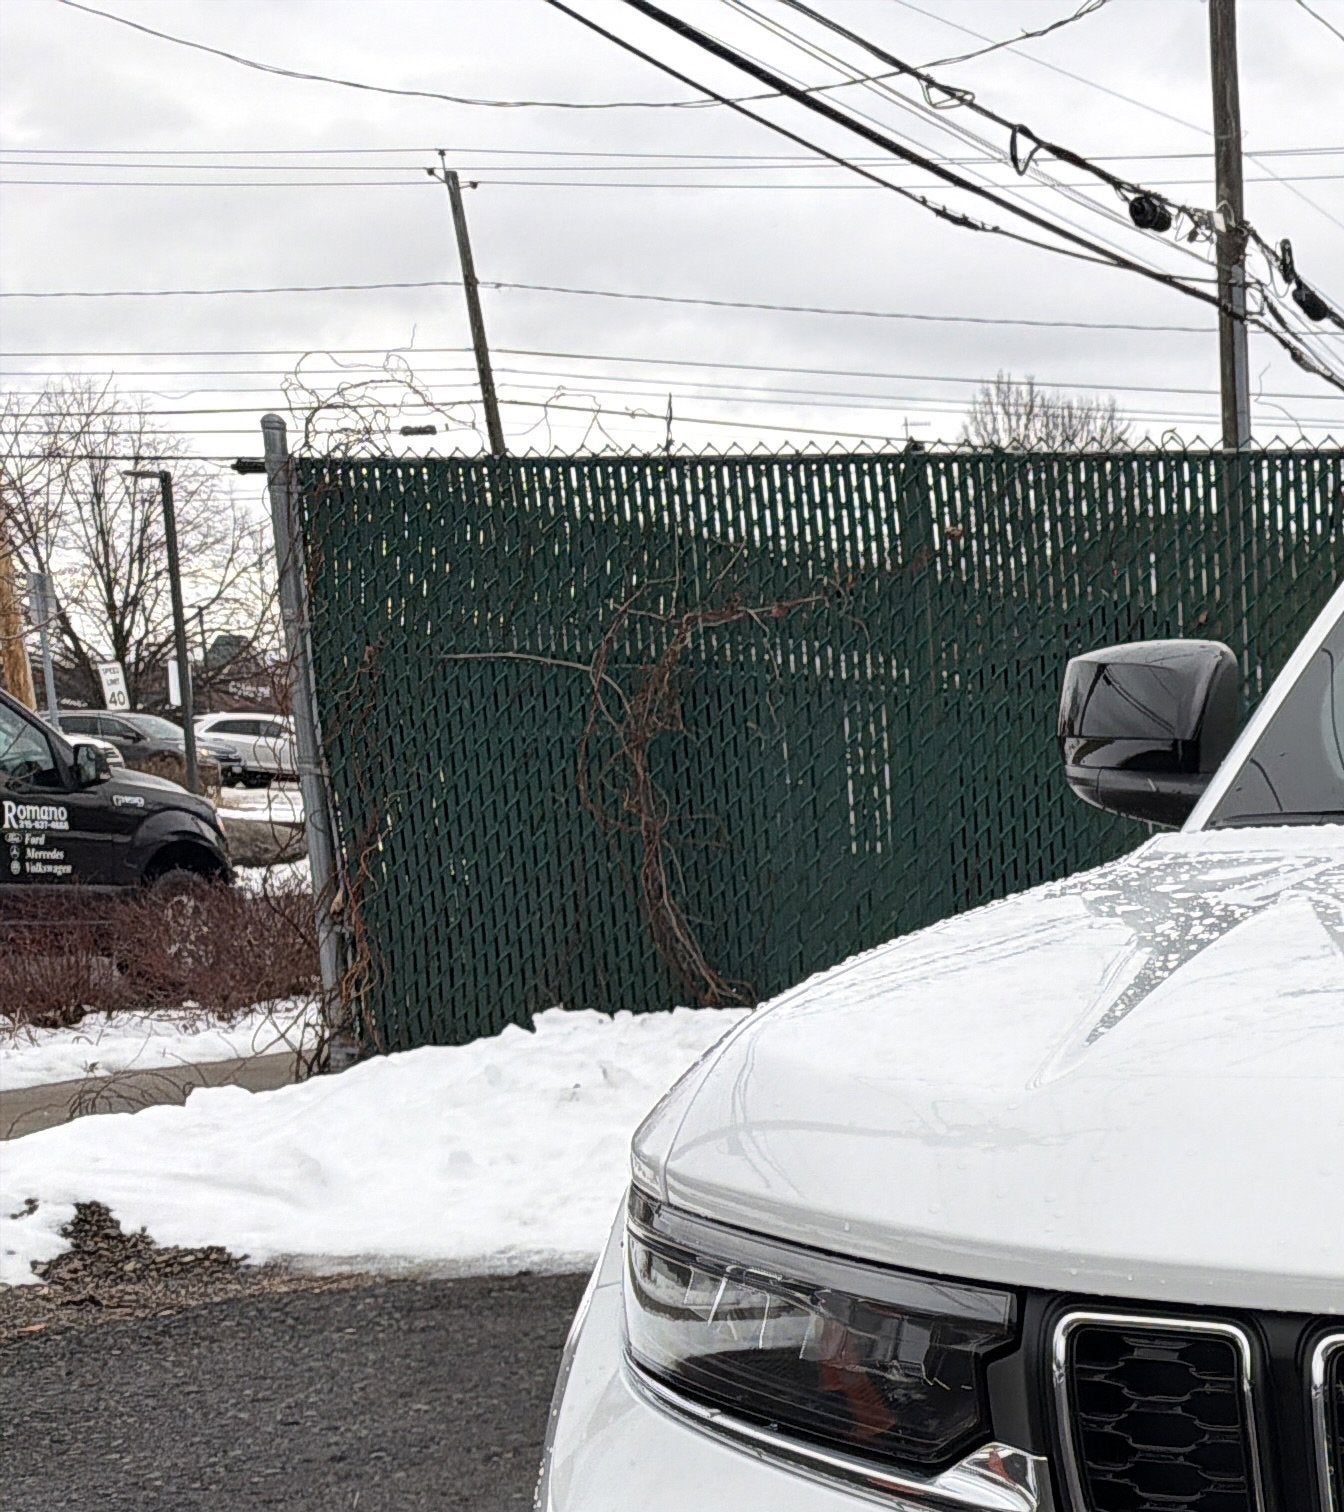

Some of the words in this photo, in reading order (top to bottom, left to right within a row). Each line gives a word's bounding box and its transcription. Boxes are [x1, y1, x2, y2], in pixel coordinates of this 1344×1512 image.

[109, 690, 126, 706] 40
[2, 800, 68, 829] Romano
[24, 833, 46, 845] Ford
[25, 847, 65, 860] Mercedes
[25, 861, 72, 876] Volkswagen
